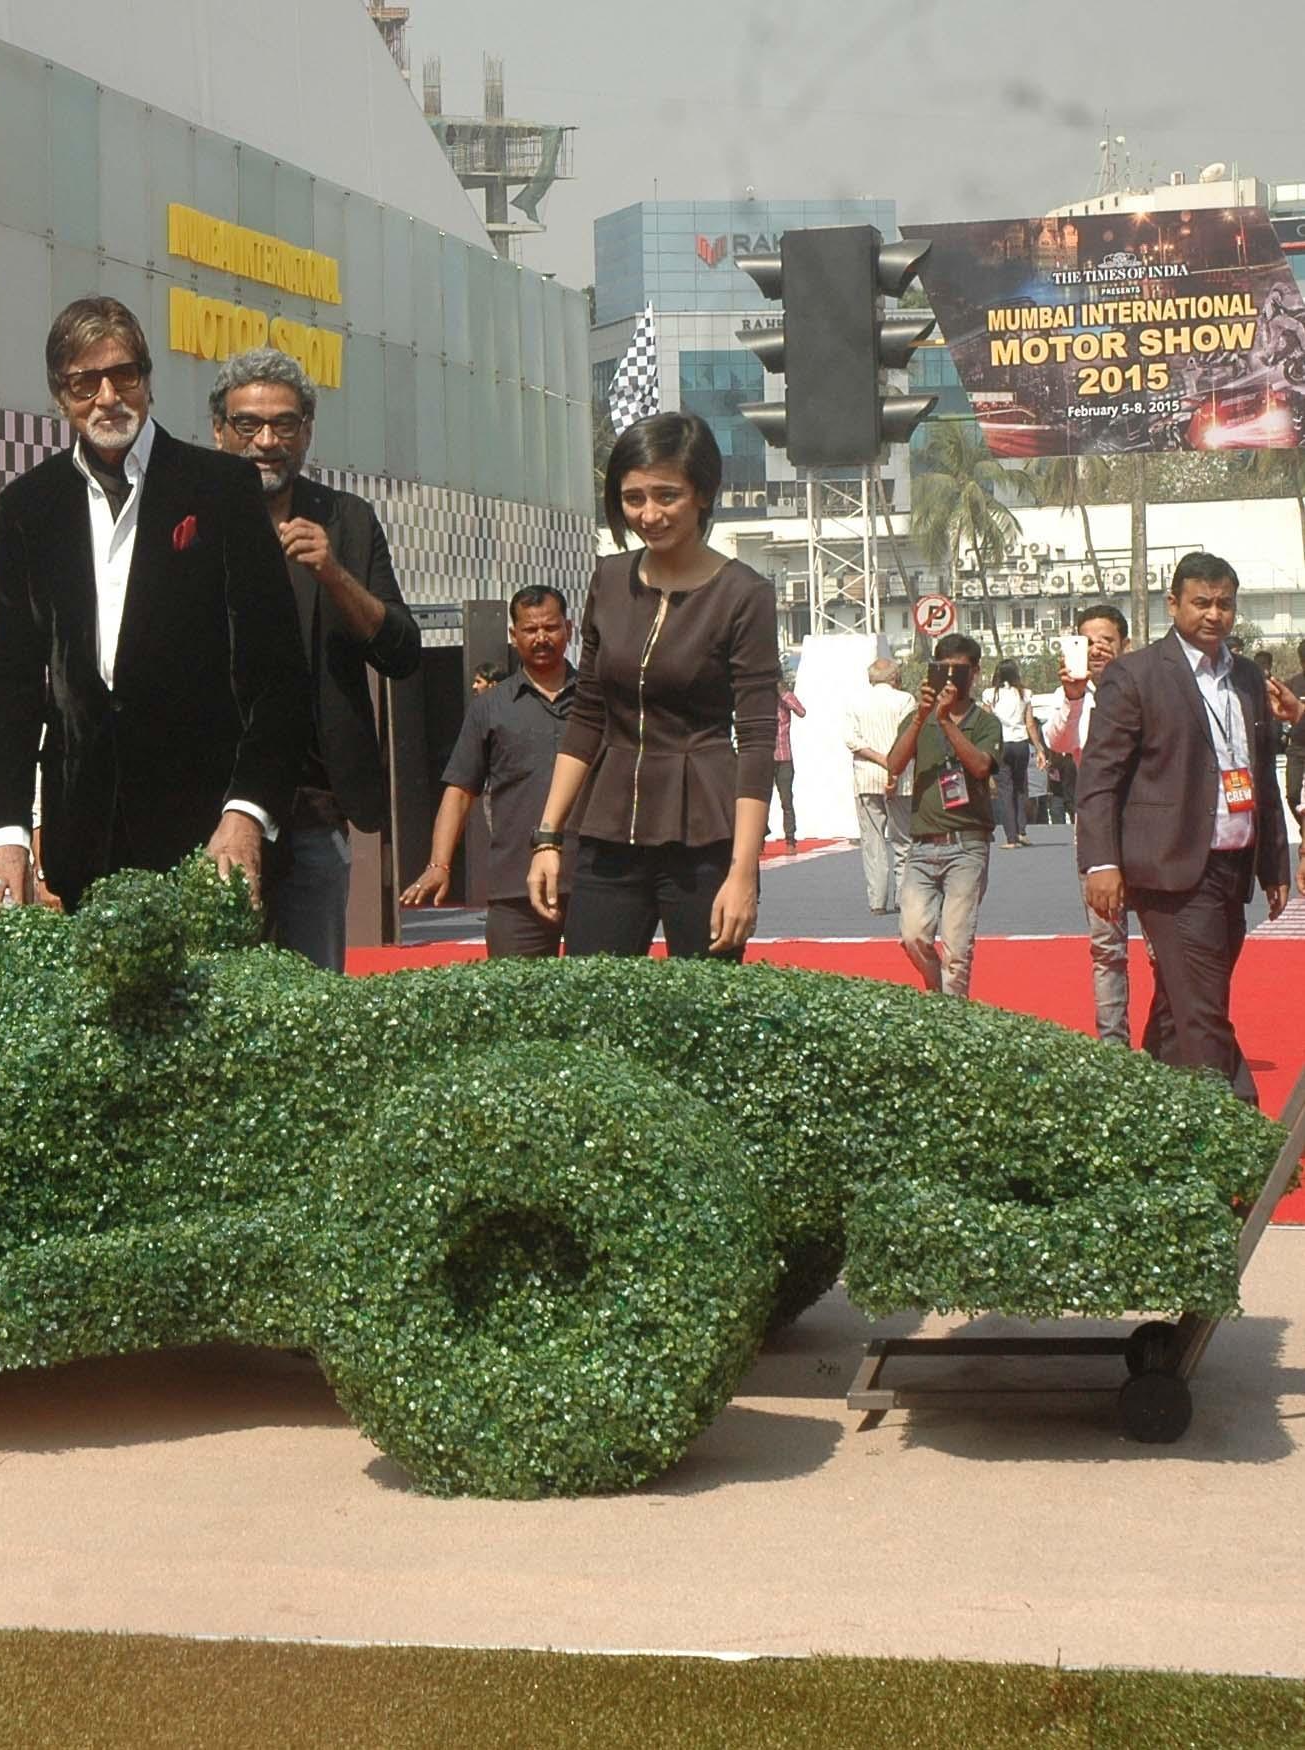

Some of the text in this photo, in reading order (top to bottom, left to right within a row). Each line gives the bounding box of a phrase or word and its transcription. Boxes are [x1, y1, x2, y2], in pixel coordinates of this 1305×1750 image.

[1053, 263, 1189, 285] THE TIMES OF INDIA
[1101, 286, 1141, 295] PRESENTS
[988, 293, 1257, 332] MUMBAI INTERNATIONAL
[990, 321, 1257, 367] MOTOR SHOW
[1078, 362, 1169, 396] 2015
[1067, 404, 1119, 418] February
[1149, 399, 1180, 413] 2015
